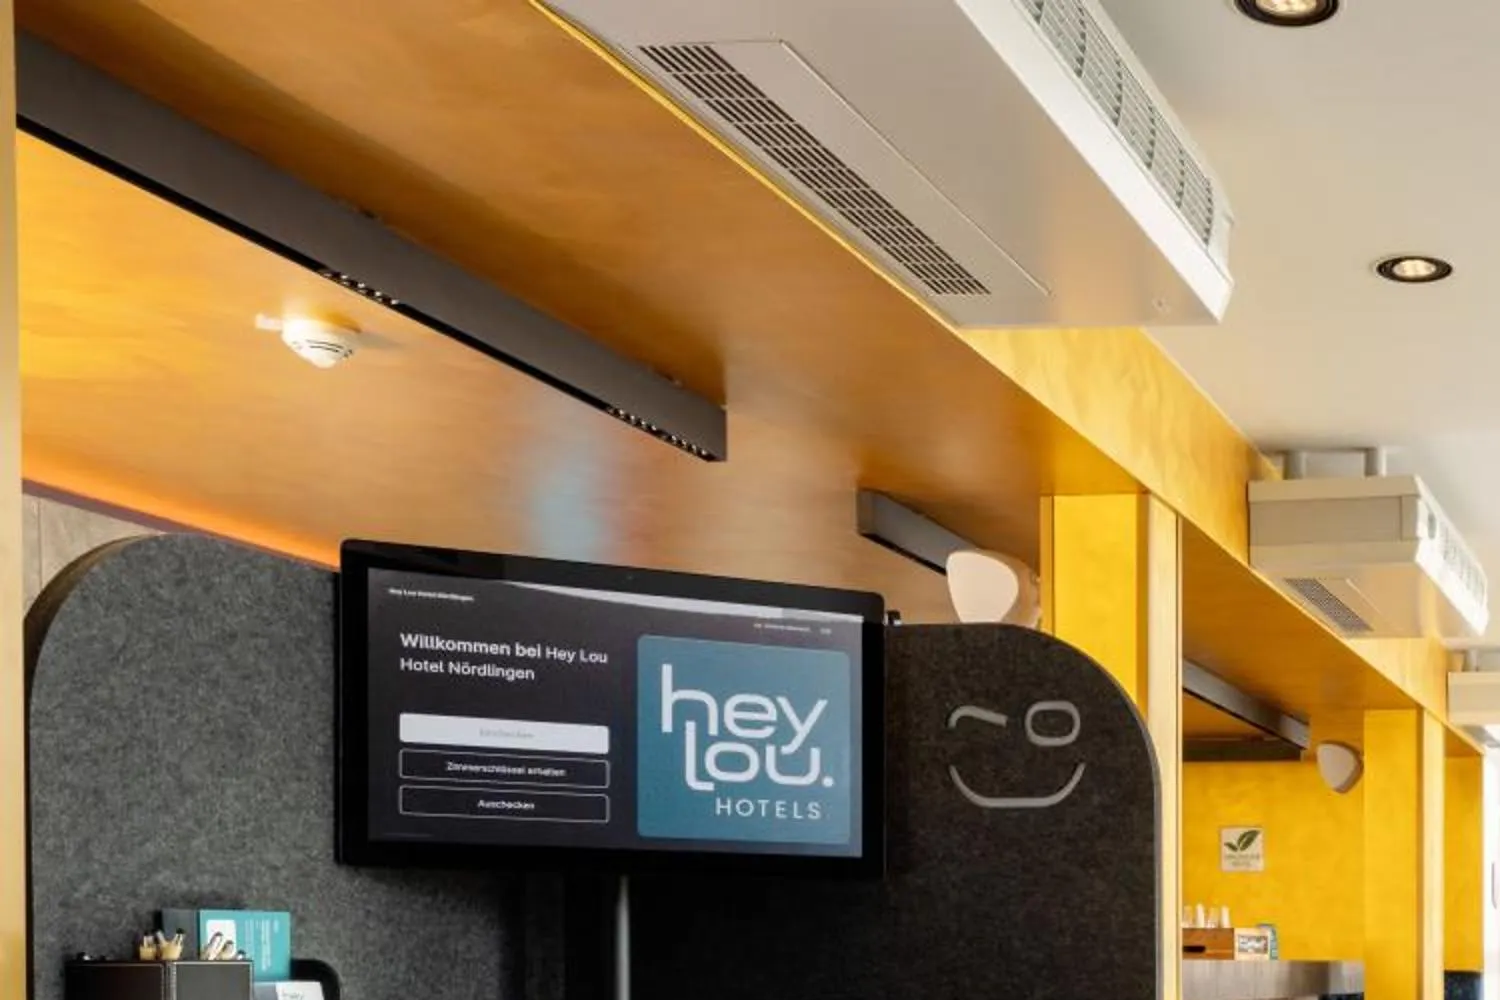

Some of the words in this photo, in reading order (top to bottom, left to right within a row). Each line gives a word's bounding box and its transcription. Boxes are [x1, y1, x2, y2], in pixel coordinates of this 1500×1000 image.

[400, 633, 511, 657] Willkommen
[514, 642, 541, 659] bei
[545, 648, 576, 664] Hey
[579, 649, 609, 664] Lou
[400, 657, 445, 674] Hotel
[448, 661, 535, 682] Nördlingen
[661, 663, 828, 755] hey
[715, 797, 822, 820] HOTELS
